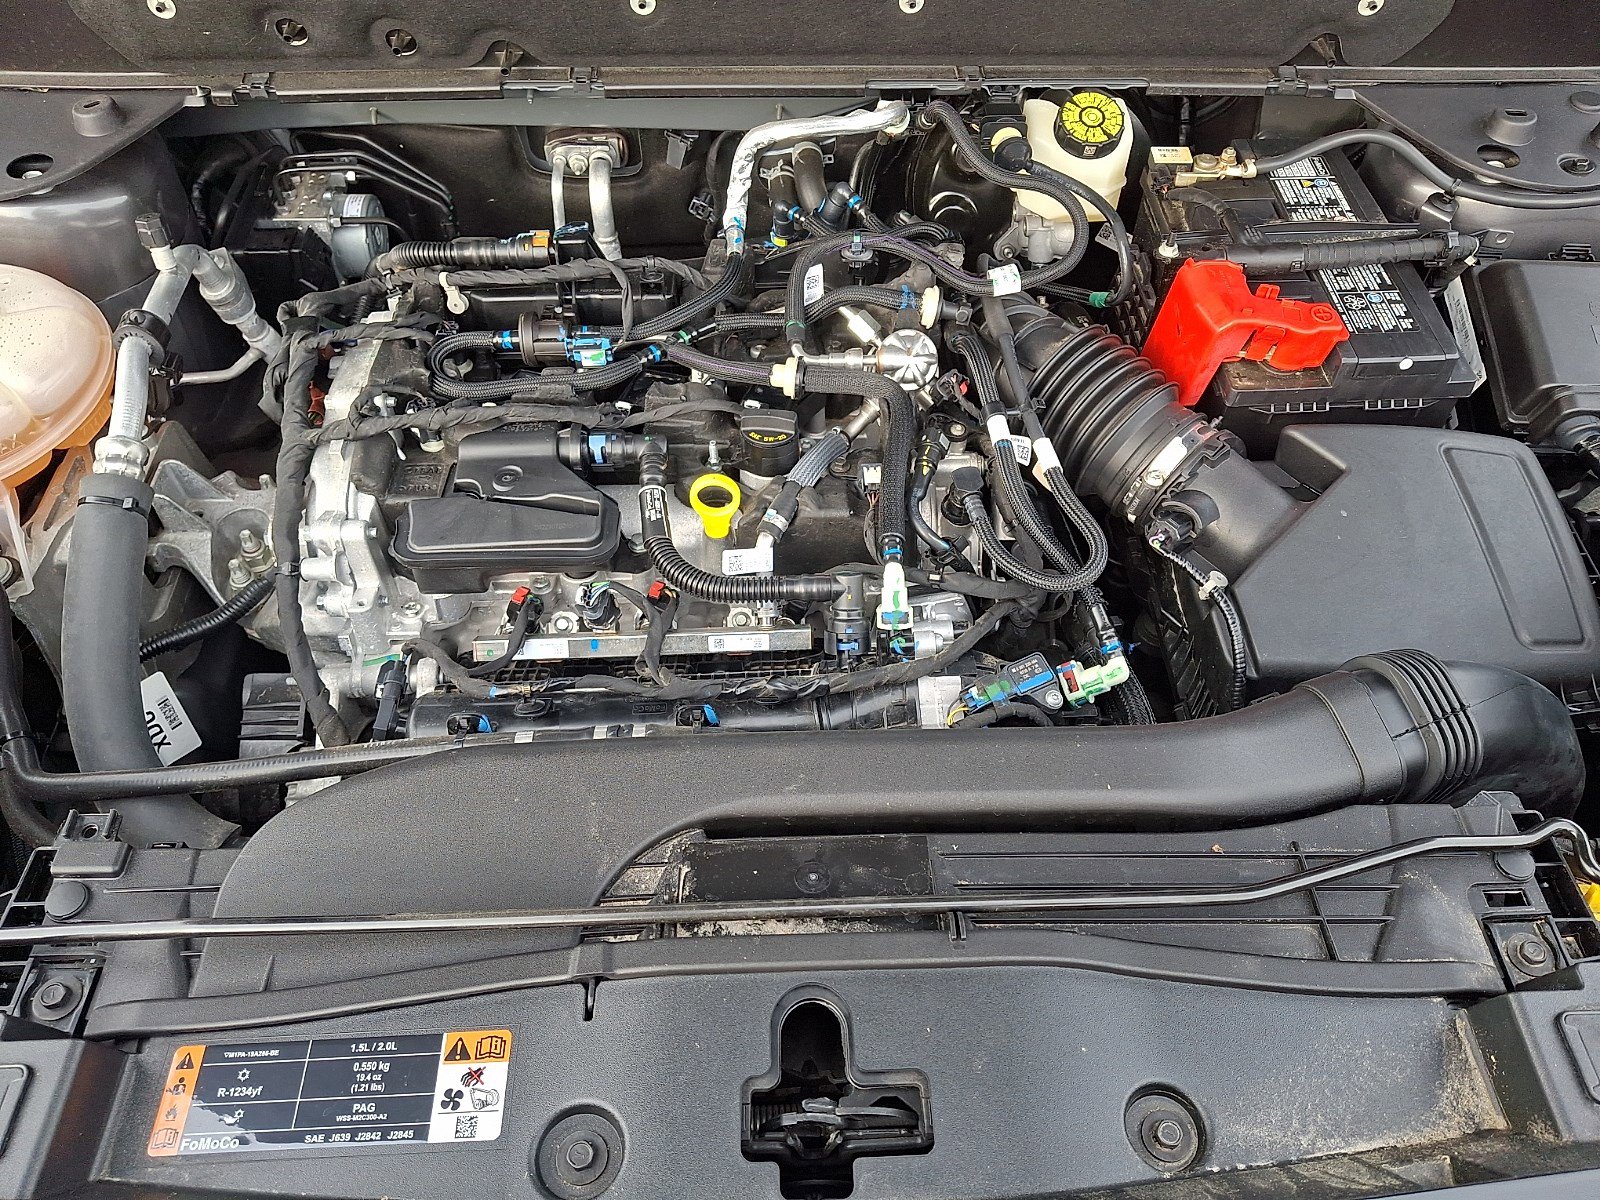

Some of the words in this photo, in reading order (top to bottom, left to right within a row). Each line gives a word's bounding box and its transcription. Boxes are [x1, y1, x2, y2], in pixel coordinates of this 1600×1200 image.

[351, 1043, 370, 1053] 1.5L
[371, 1042, 377, 1052] /
[377, 1041, 398, 1051] 2.0L
[353, 1061, 377, 1072] 0.550
[378, 1060, 391, 1072] kg
[356, 1073, 371, 1082] 19.4
[372, 1073, 382, 1081] oz
[217, 1086, 263, 1098] R-1234yf
[350, 1084, 369, 1094] (1.21
[370, 1082, 385, 1093] lbs)
[352, 1103, 376, 1113] PAG
[304, 1134, 325, 1143] SAE
[329, 1133, 351, 1142] J639
[355, 1132, 382, 1141] J2842
[387, 1130, 414, 1140] J2845
[180, 1136, 240, 1151] FoMoCo
